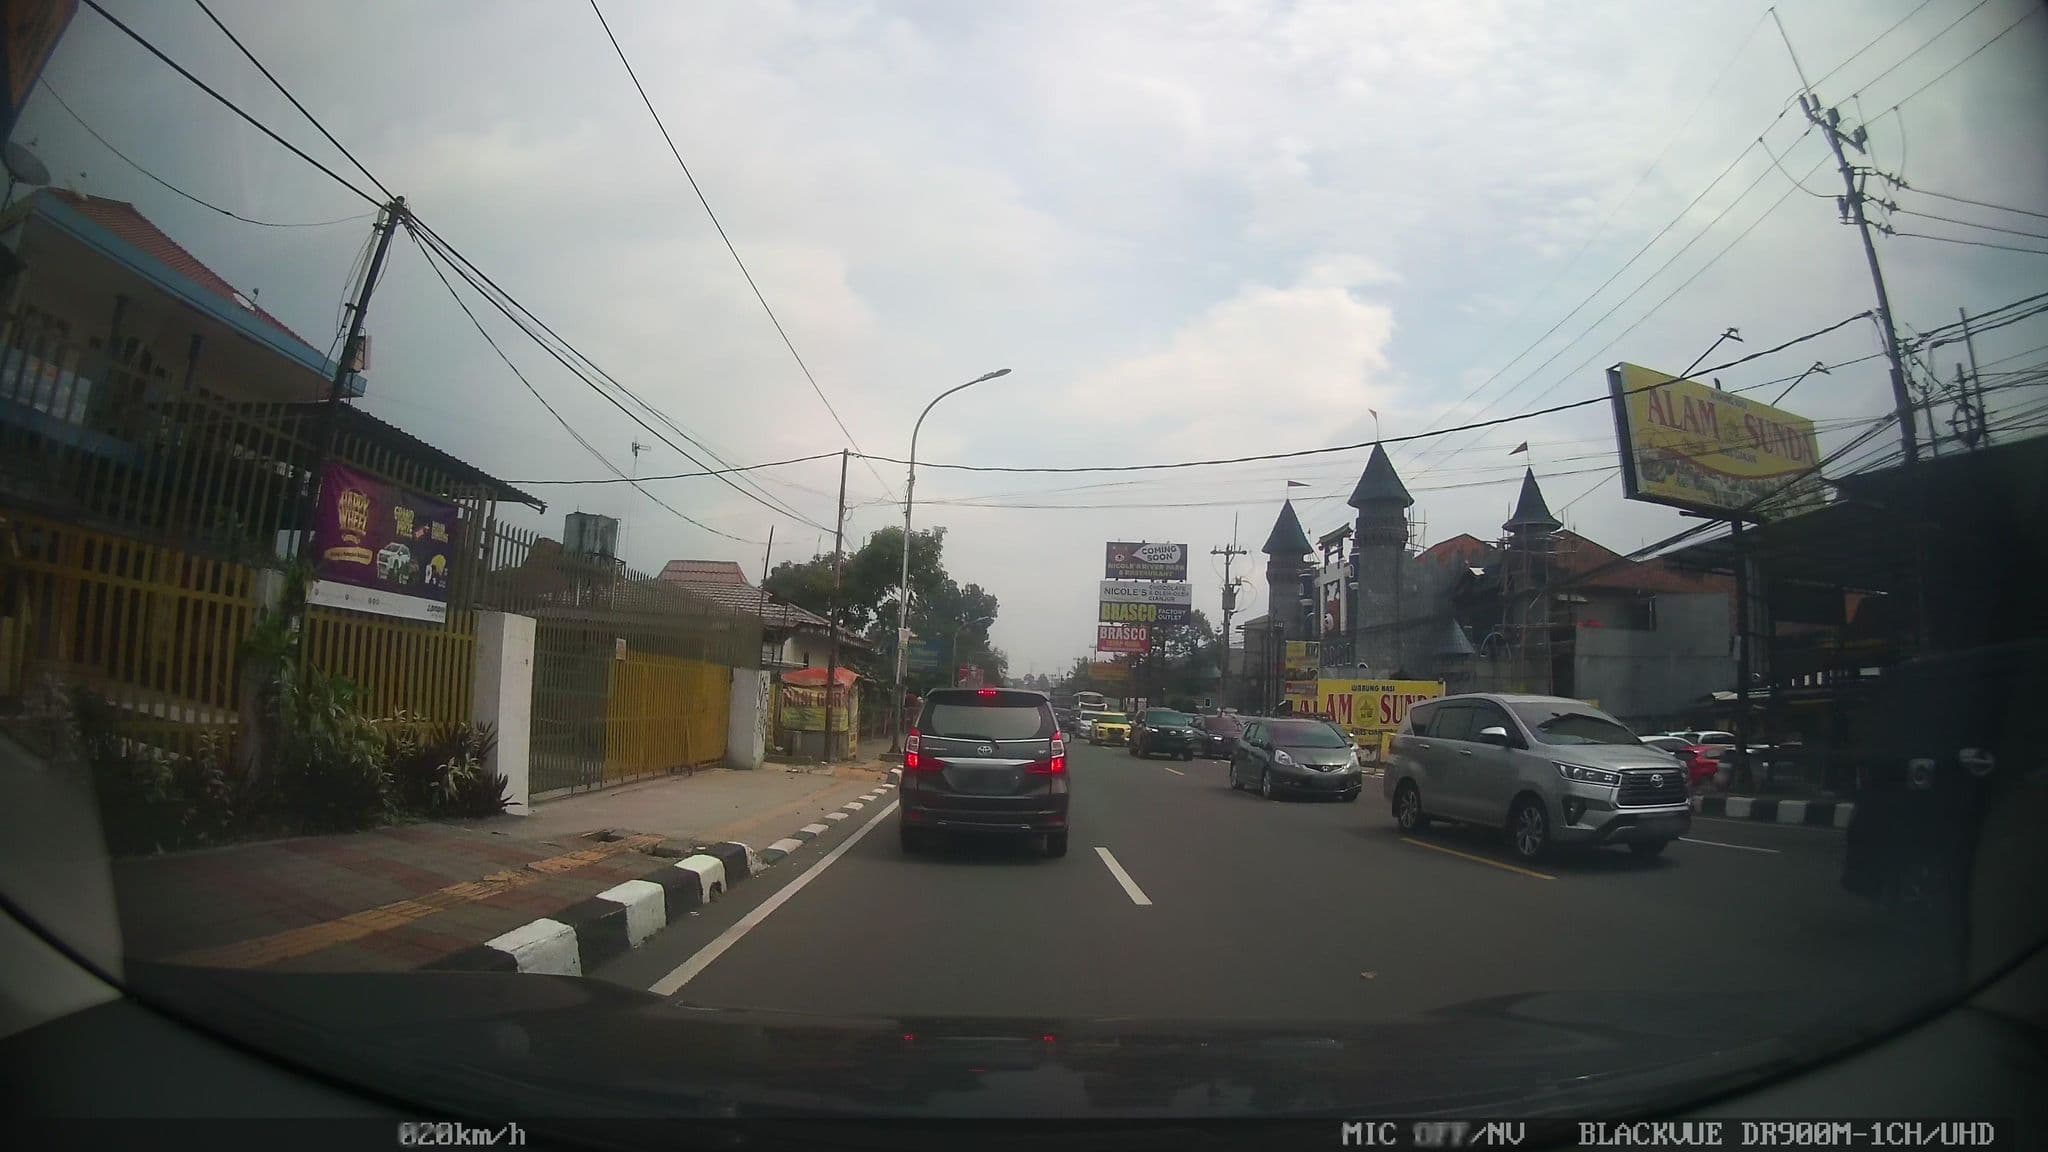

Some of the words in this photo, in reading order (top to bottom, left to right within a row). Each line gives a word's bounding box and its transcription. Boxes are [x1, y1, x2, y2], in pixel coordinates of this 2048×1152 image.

[1647, 389, 1721, 442] ALAM
[1744, 413, 1817, 466] SUNDA
[1141, 545, 1177, 555] COMING
[1147, 553, 1173, 561] SOON
[1103, 587, 1147, 596] NICOLE'S
[1102, 603, 1157, 622] BRASCO
[1100, 627, 1146, 640] BRASCO
